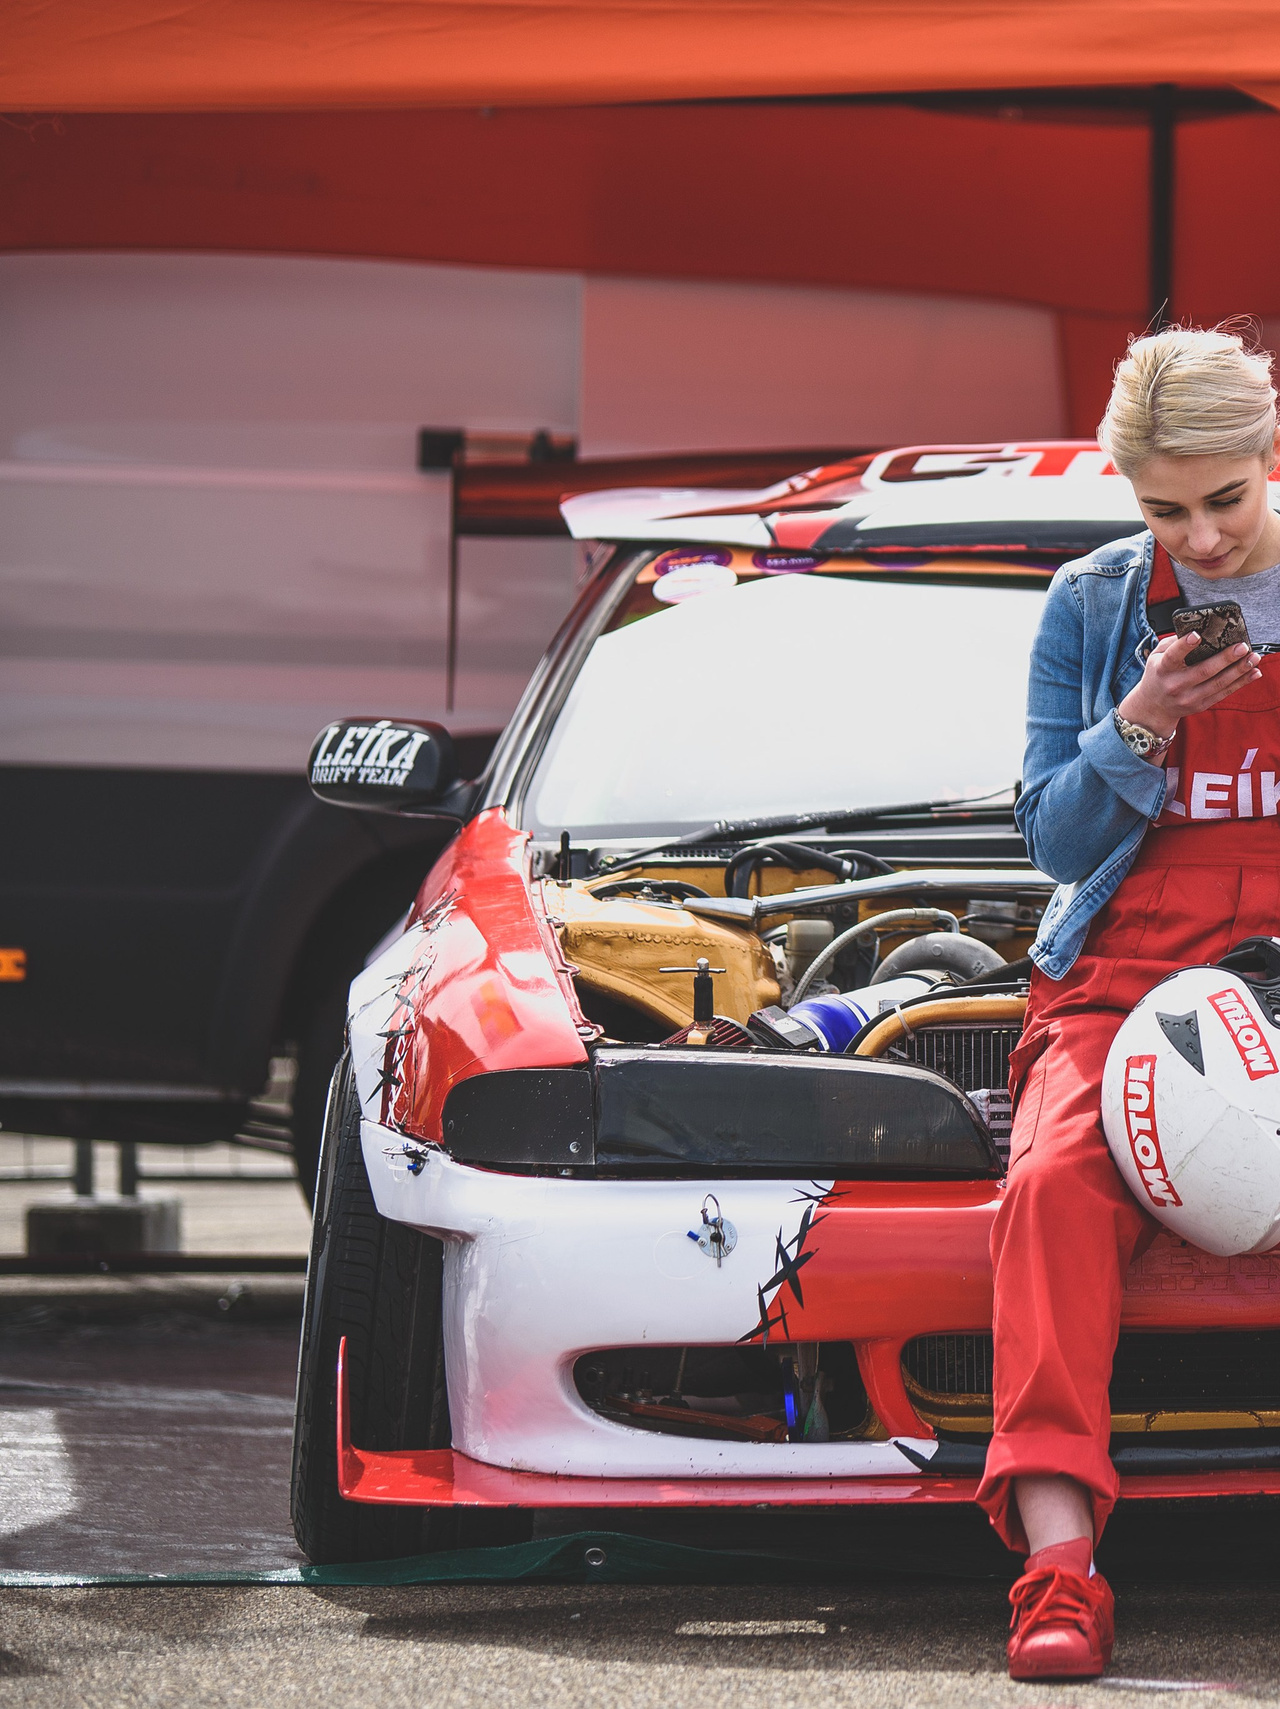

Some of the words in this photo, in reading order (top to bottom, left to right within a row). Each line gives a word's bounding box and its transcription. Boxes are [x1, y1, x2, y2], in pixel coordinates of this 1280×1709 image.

[311, 766, 355, 785] DRIFT
[358, 766, 410, 787] TEAM
[313, 719, 430, 770] LEÍKA
[1212, 990, 1279, 1074] MOTUL
[1126, 1062, 1177, 1204] MOTUL
